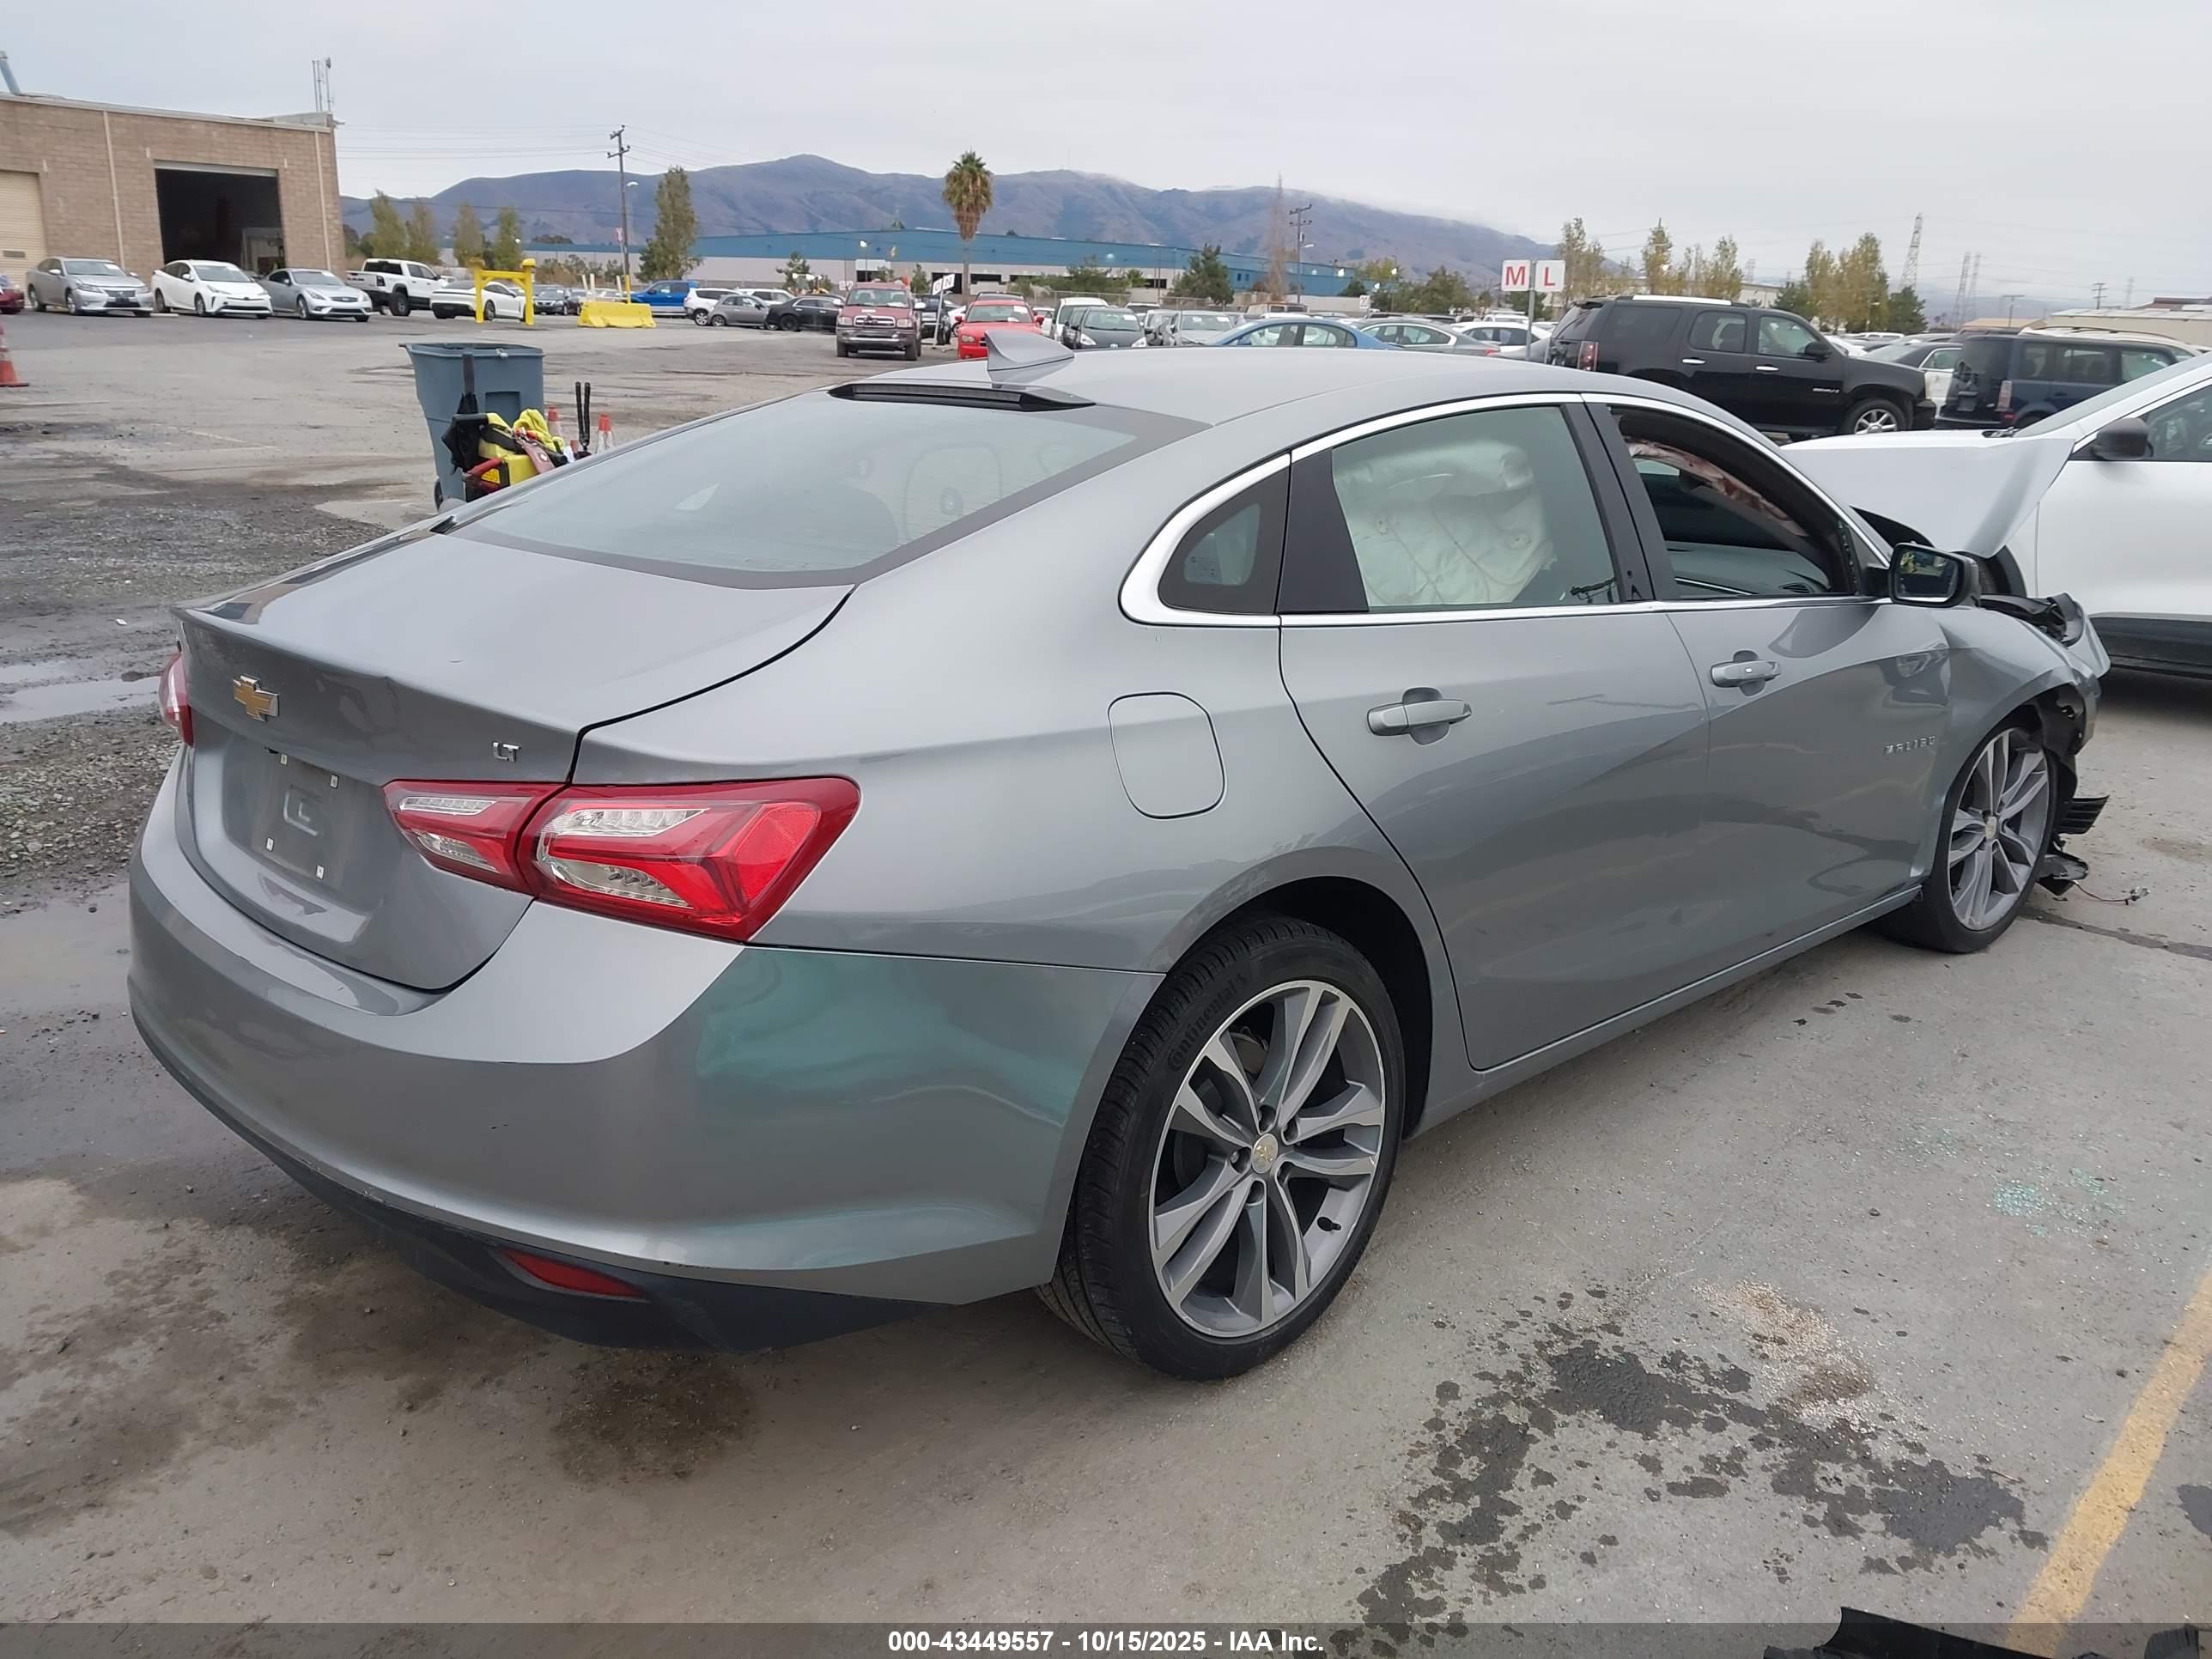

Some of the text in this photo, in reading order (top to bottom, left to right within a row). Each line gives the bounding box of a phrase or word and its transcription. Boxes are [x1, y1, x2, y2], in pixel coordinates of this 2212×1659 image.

[945, 276, 953, 288] N
[1505, 266, 1556, 286] M L
[492, 742, 520, 763] LT
[1169, 979, 1237, 1071] Continental
